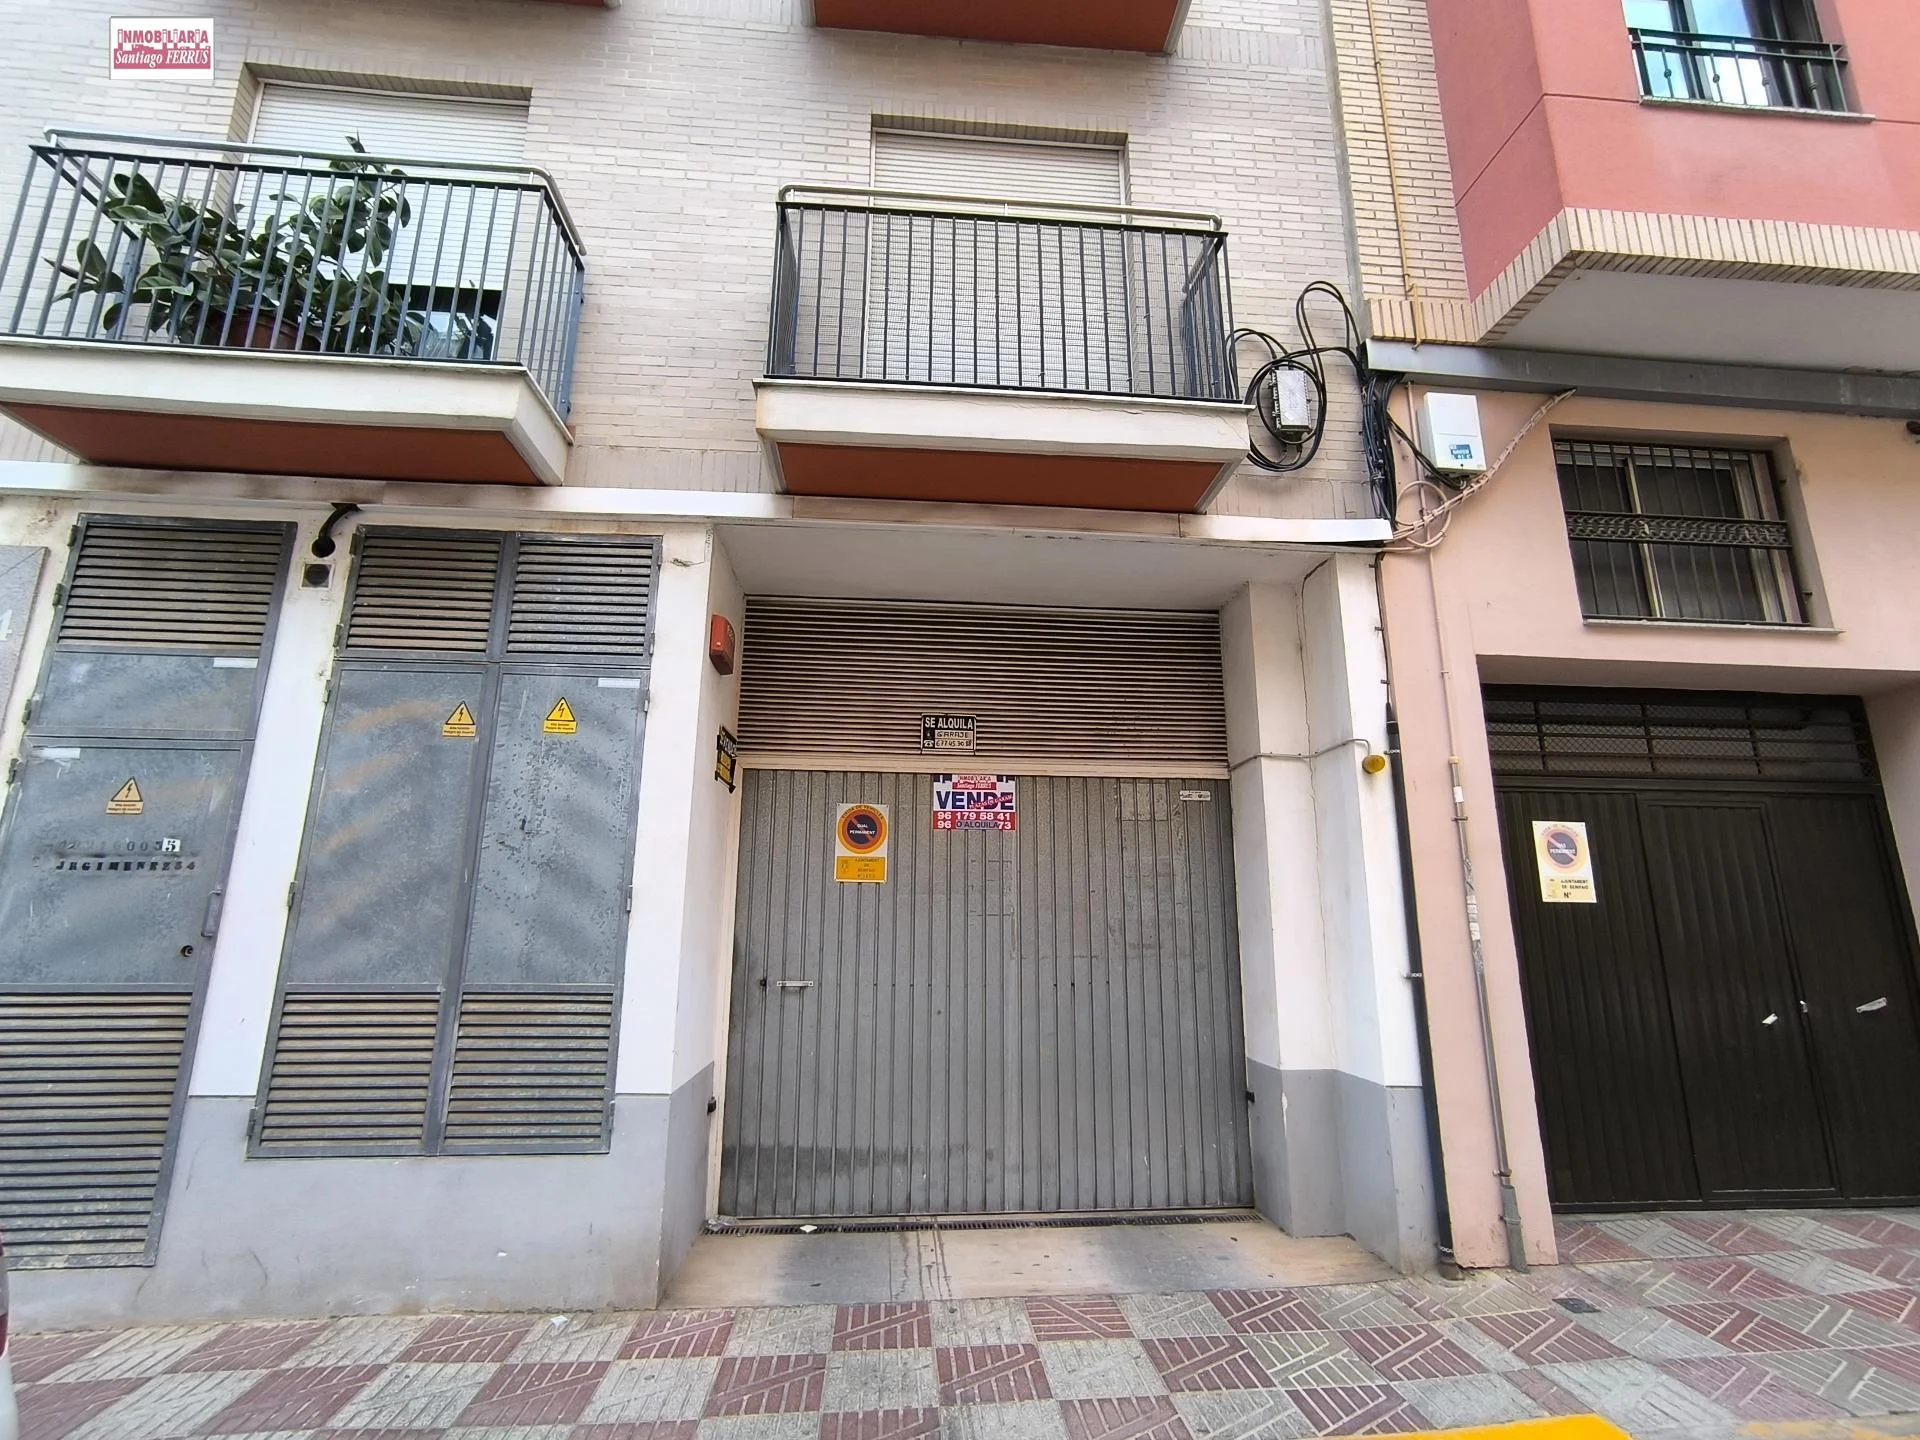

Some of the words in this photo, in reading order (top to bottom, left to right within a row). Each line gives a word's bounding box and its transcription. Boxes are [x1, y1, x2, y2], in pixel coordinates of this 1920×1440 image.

[924, 716, 936, 728] SE
[937, 717, 973, 730] ALQUILA
[936, 790, 1014, 811] VENDE
[937, 811, 952, 820] 96
[955, 812, 976, 821] 179
[979, 812, 994, 821] 58
[996, 812, 1011, 821] 41
[937, 820, 952, 829] 96
[997, 821, 1012, 830] 73
[956, 820, 963, 828] O
